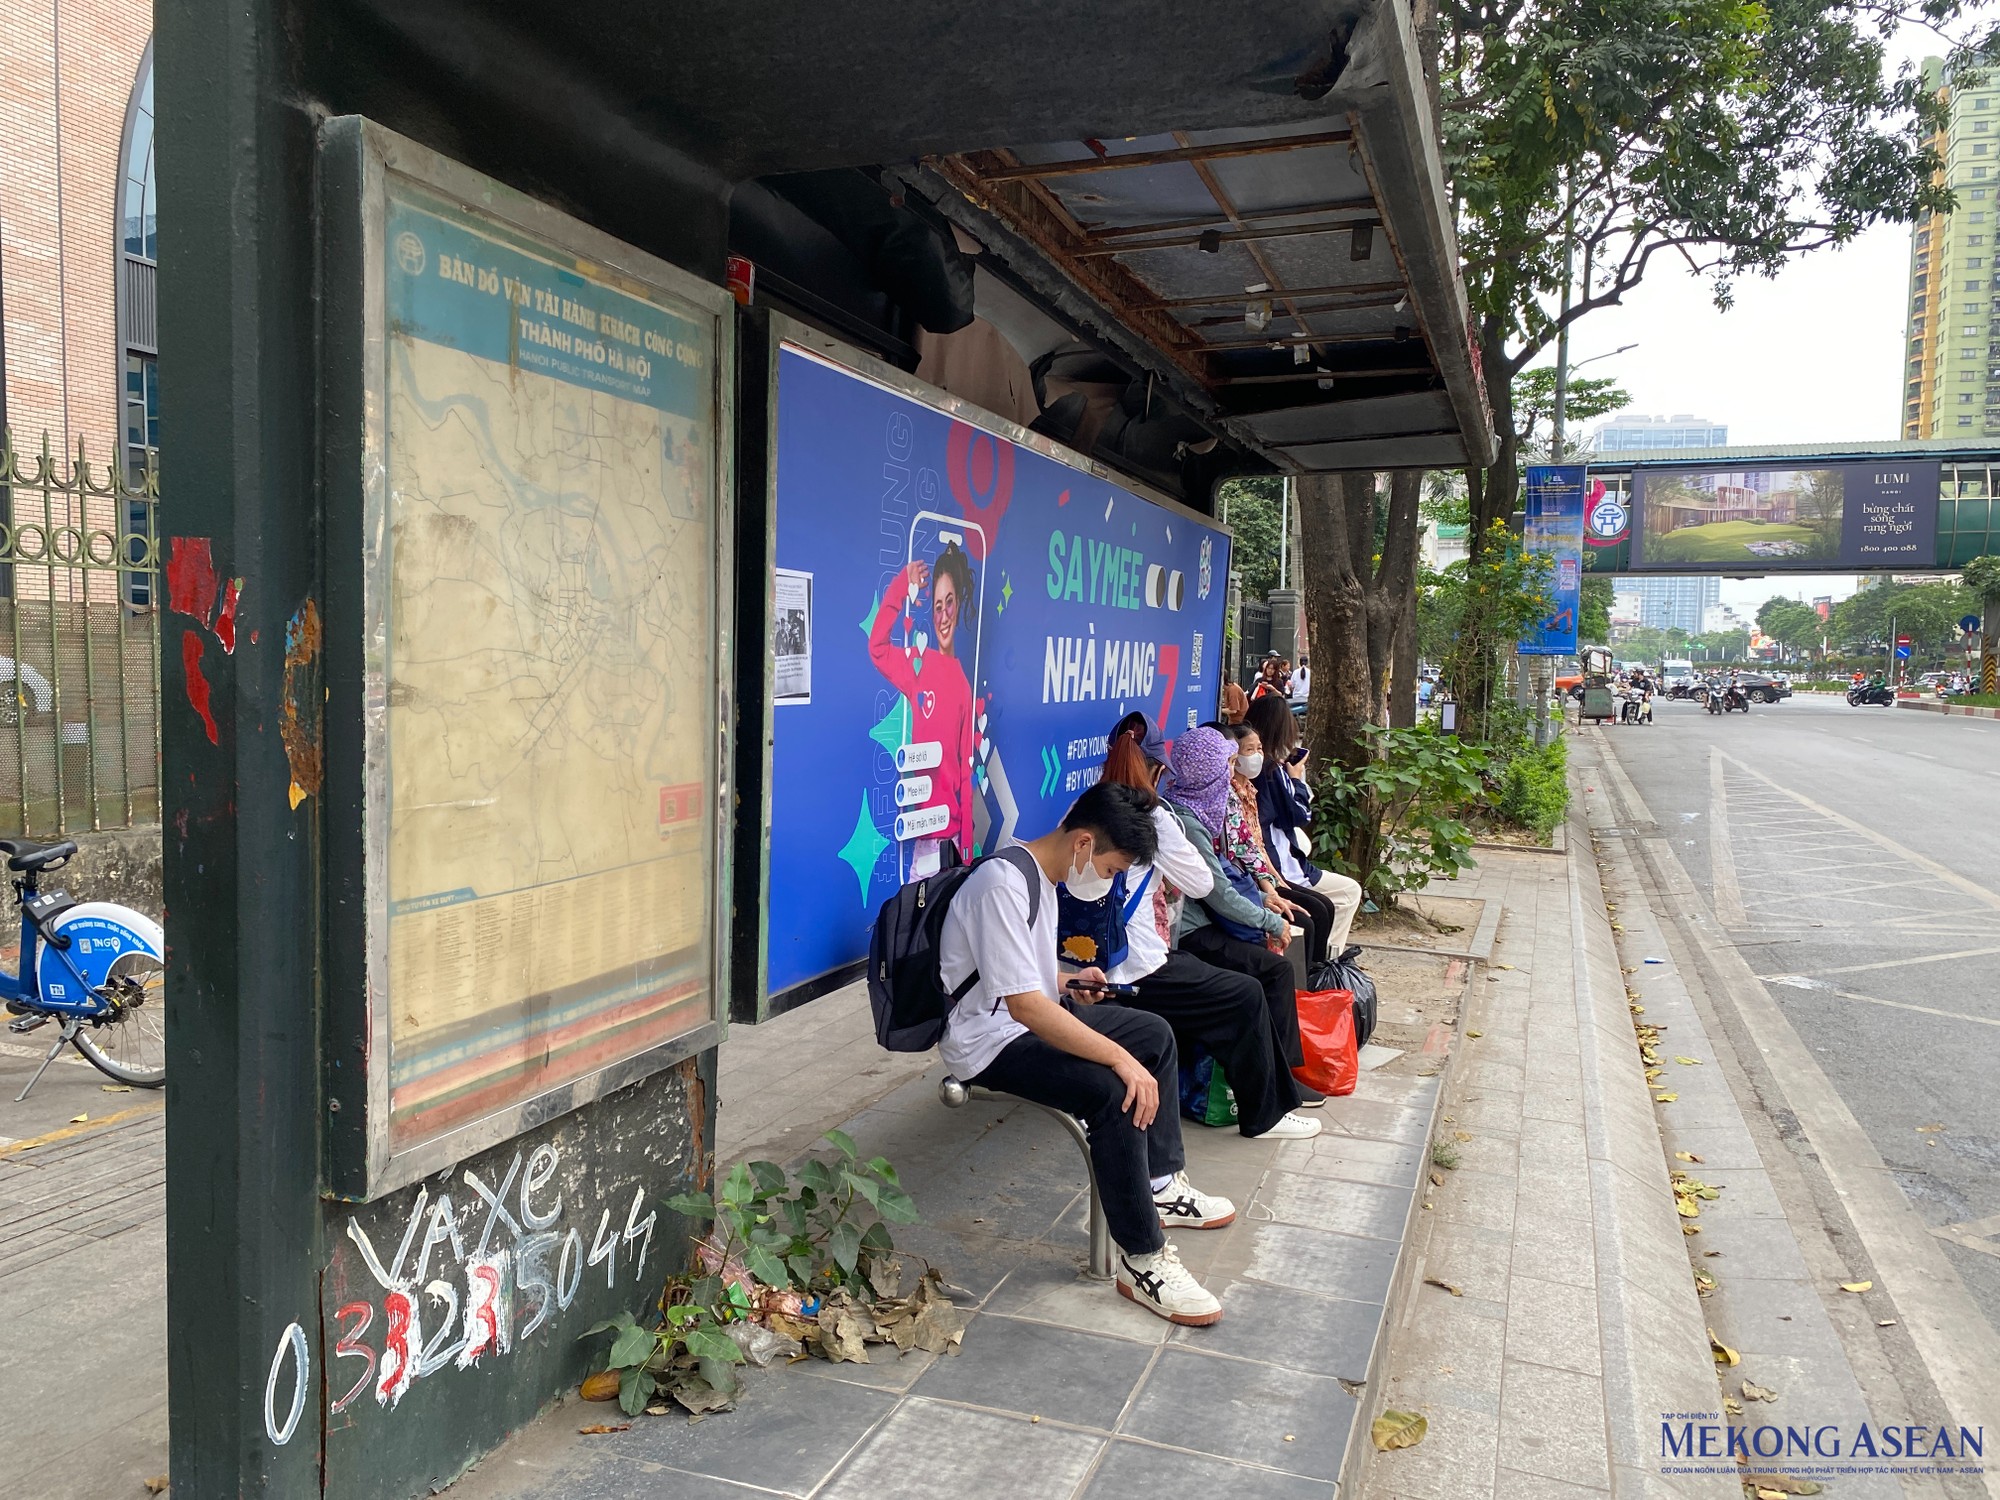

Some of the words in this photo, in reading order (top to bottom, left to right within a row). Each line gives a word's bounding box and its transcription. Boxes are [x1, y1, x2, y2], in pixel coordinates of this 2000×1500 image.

[562, 298, 596, 331] HÀNH
[600, 312, 641, 347] KHÁCH
[519, 317, 572, 354] THÀNH
[574, 339, 606, 364] PHỐ
[608, 346, 625, 372] HÀ
[626, 354, 651, 382] NỘI
[518, 350, 549, 367] HANOI
[551, 357, 580, 377] PUBLIC
[582, 369, 632, 392] TRANSPORT
[1874, 472, 1910, 485] LUMI
[1891, 502, 1915, 513] chất
[1863, 525, 1887, 535] rạng
[1889, 521, 1912, 535] ngời
[1900, 544, 1917, 552] 088
[1046, 529, 1144, 610] SAYMEE
[1043, 622, 1096, 703] NHÀ
[1101, 636, 1156, 716] MẠNG
[1067, 738, 1087, 761] #FOR
[1089, 735, 1109, 757] YOUN
[1065, 769, 1081, 792] #BY
